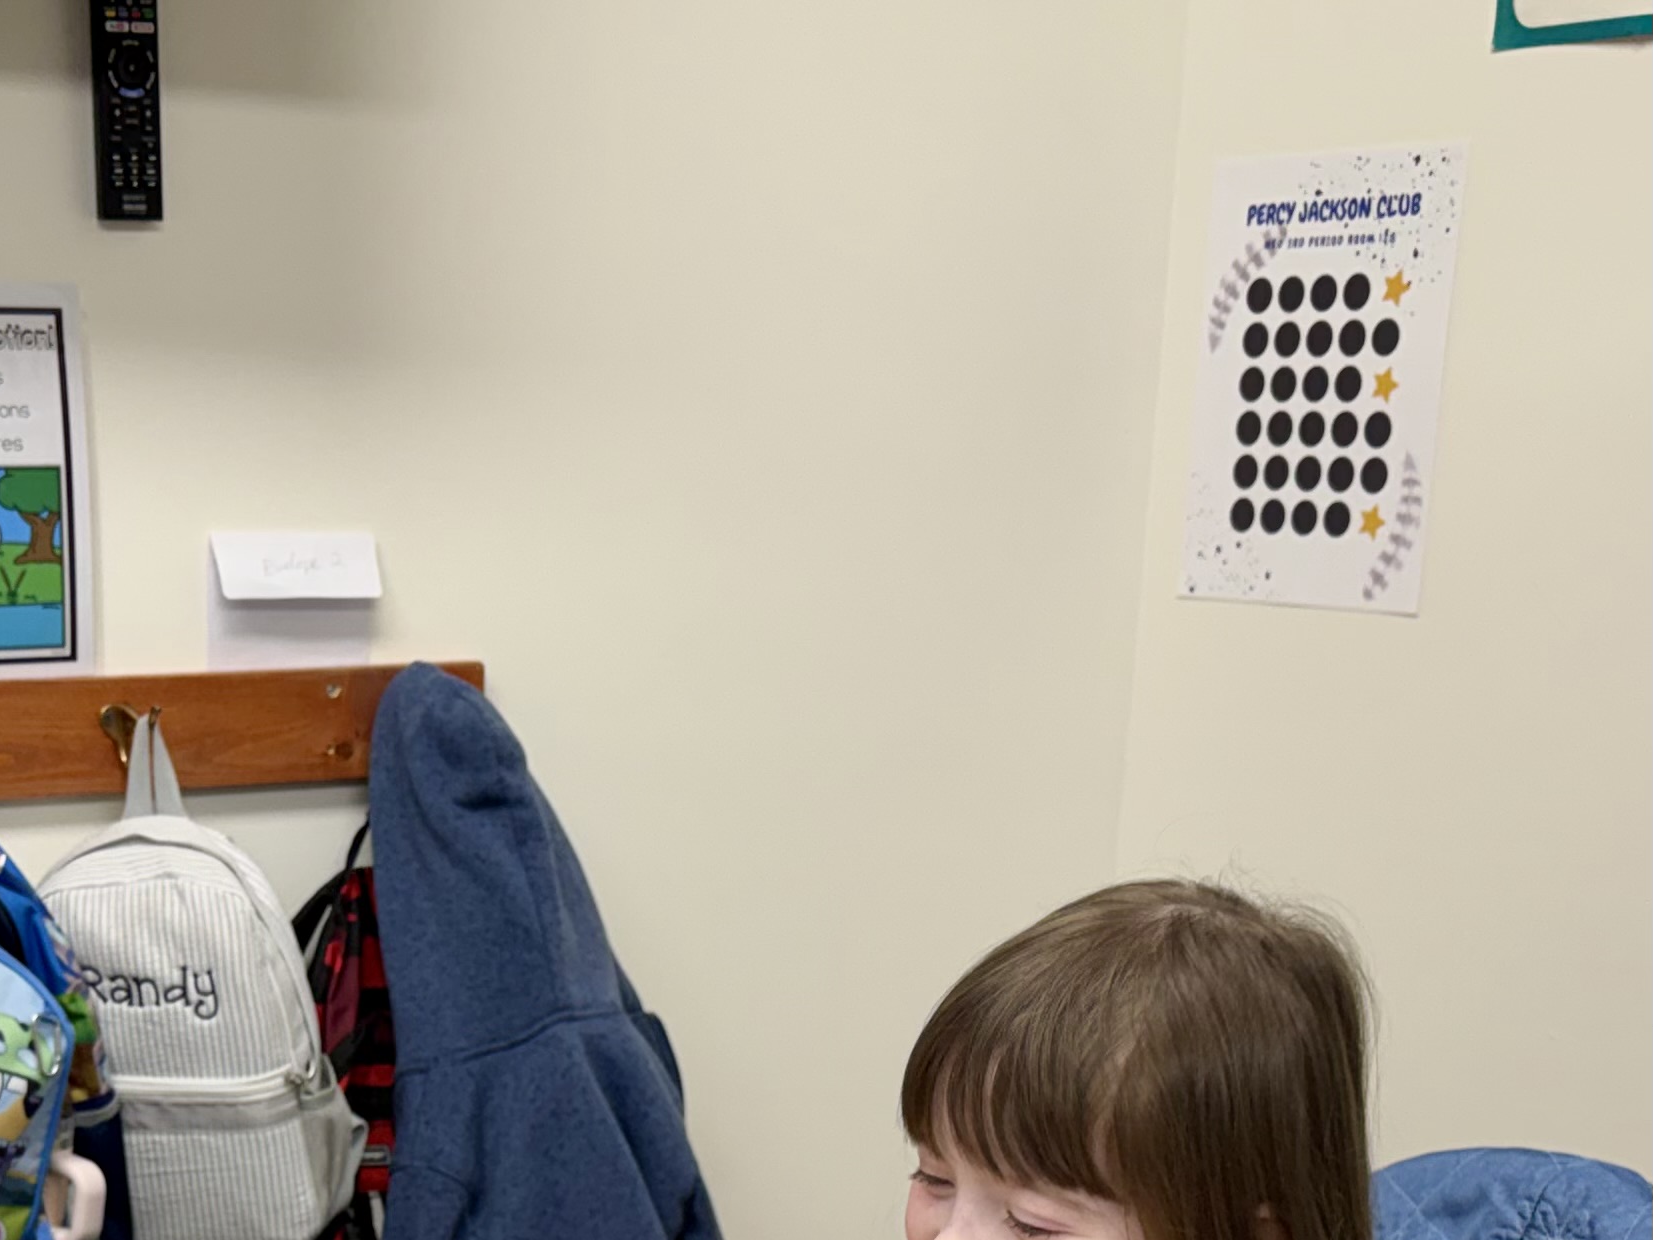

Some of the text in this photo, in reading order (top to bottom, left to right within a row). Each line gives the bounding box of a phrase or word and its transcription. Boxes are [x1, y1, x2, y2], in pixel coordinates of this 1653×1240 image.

[1246, 192, 1422, 227] PERCY JACKSON CLUB
[1347, 234, 1375, 246] ROOM
[79, 964, 219, 1020] Randy
